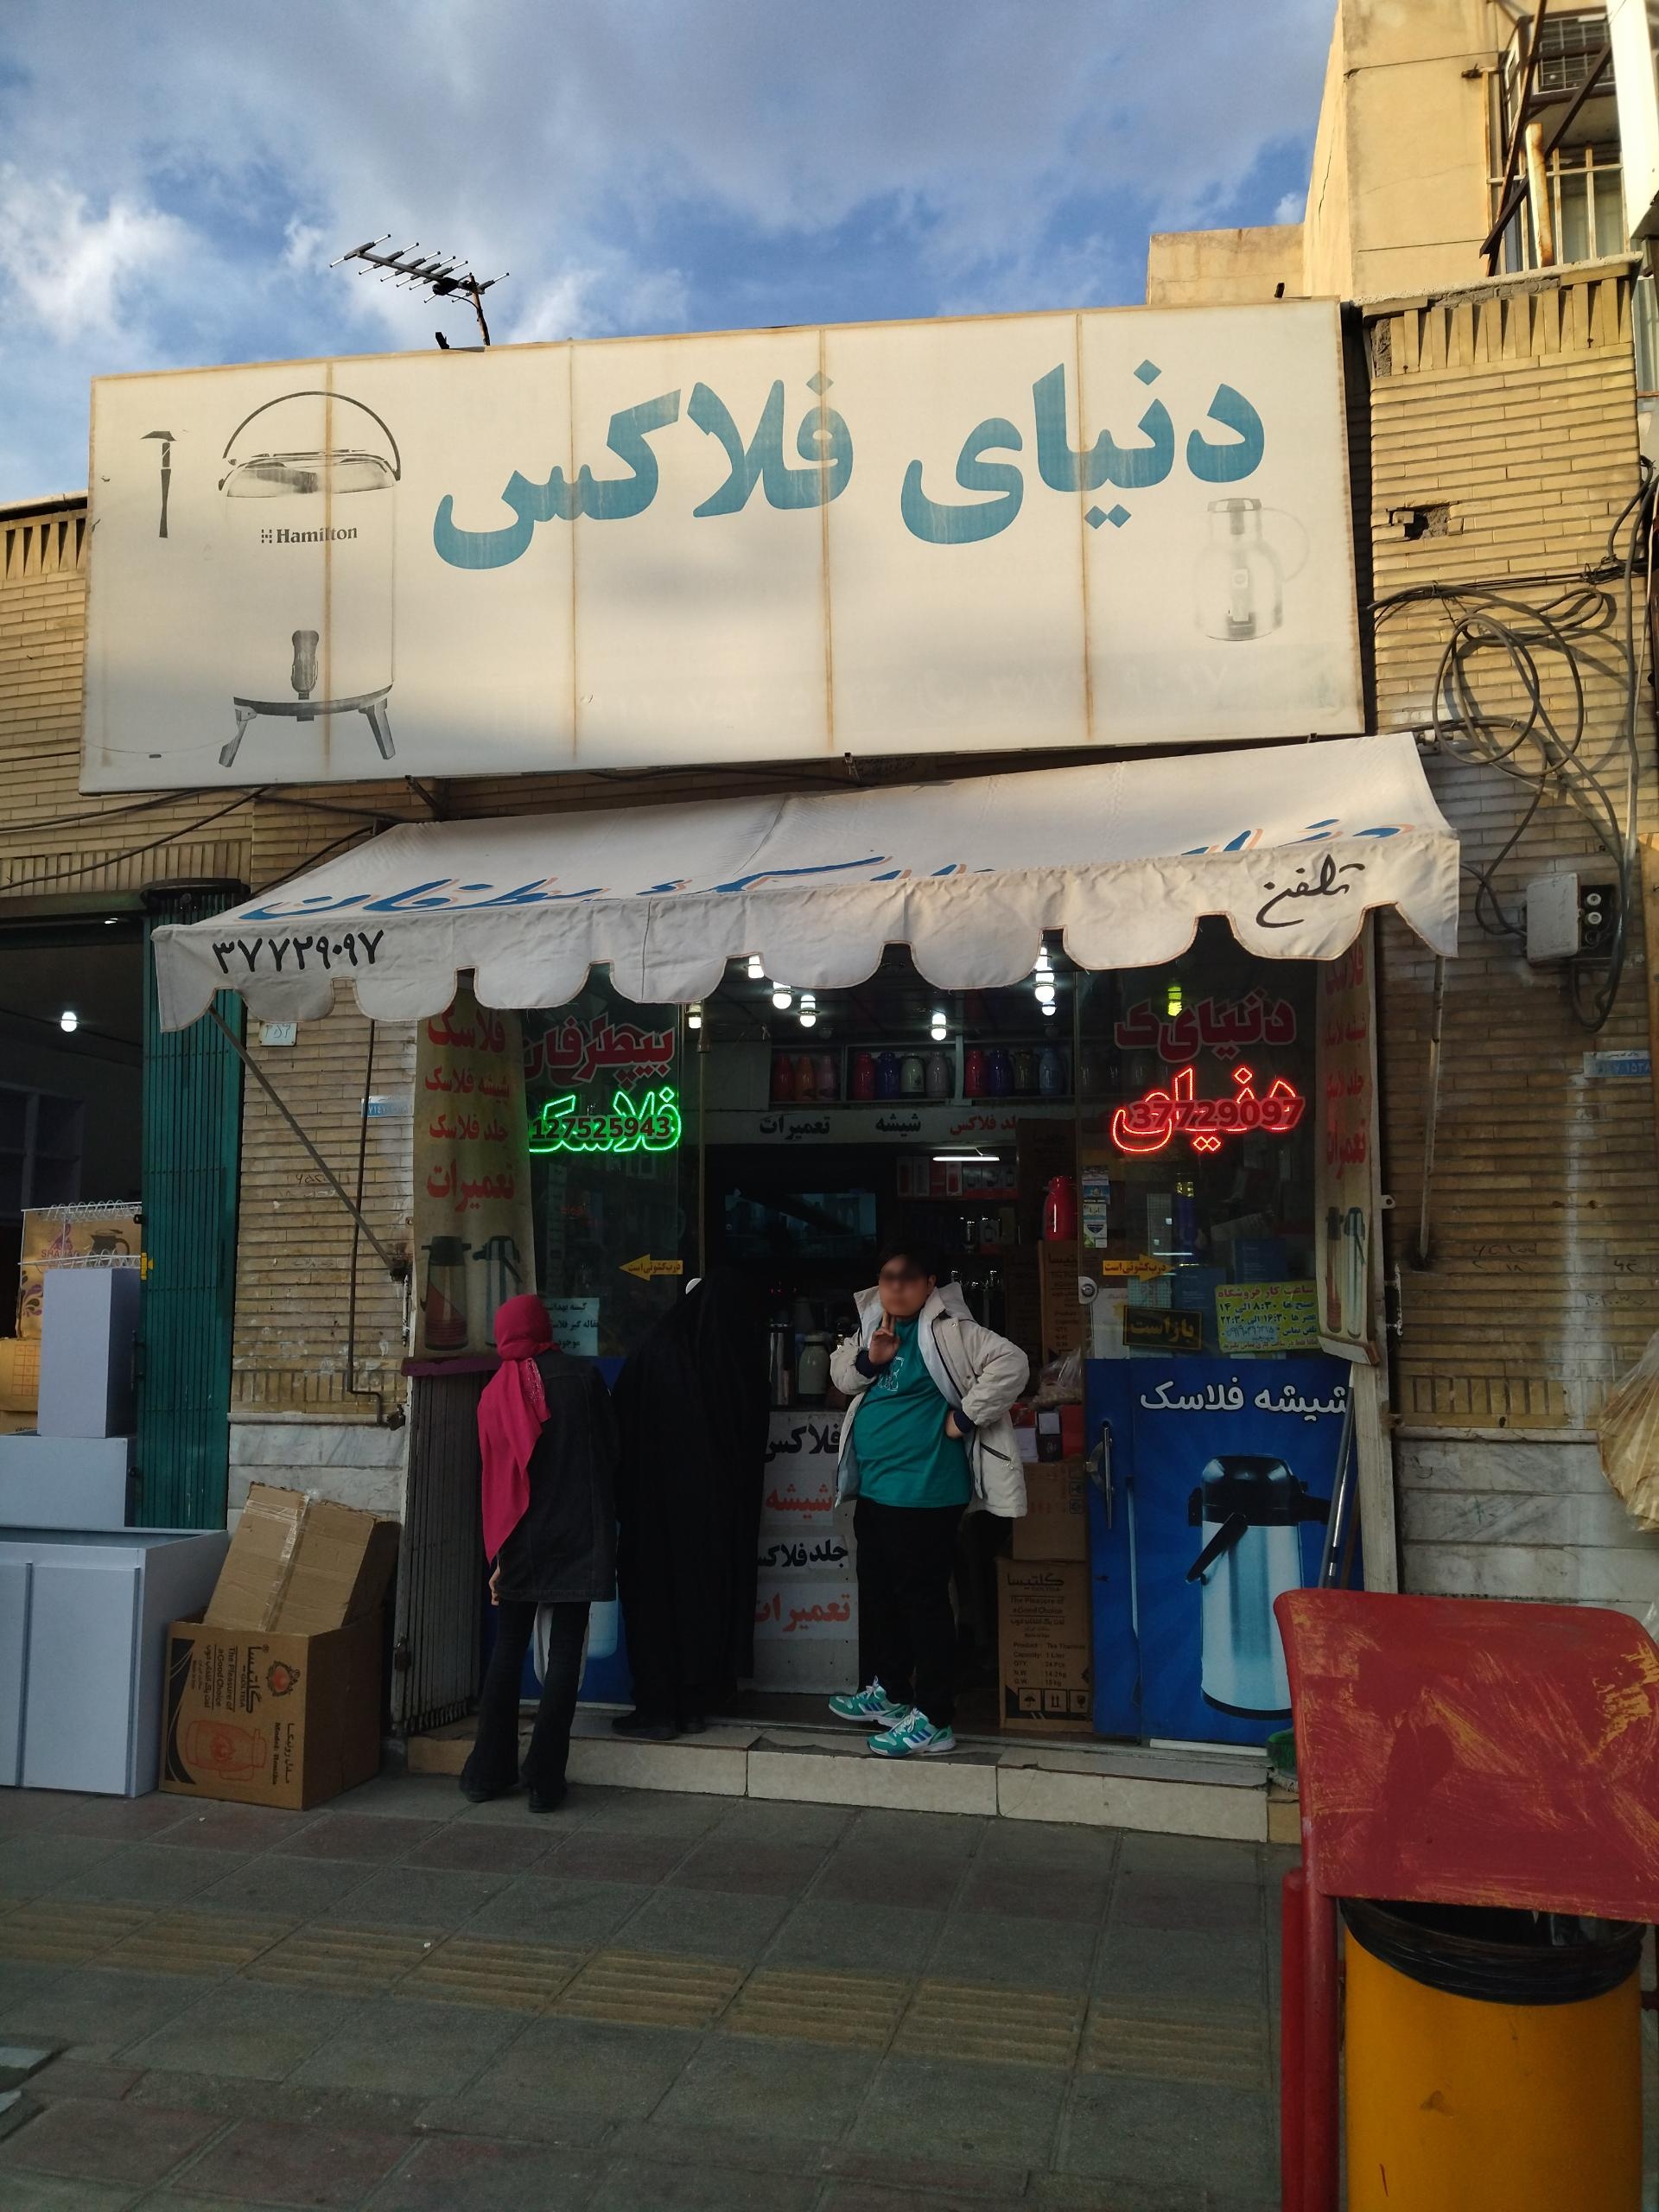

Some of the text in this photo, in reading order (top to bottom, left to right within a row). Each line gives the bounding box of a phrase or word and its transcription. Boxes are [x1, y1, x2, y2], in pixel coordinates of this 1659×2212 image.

[433, 359, 1265, 569] دنیای فلاکس
[276, 526, 358, 544] Hamilton
[1255, 854, 1365, 929] تلفن
[212, 929, 385, 975] ۳۷۷۲۹۰۹۷
[1157, 991, 1297, 1064] دنیای
[424, 1065, 474, 1094] فلاسک
[429, 1113, 480, 1141] فلاسک
[759, 1115, 831, 1141] تعمیرات
[875, 1113, 922, 1137] شیشه
[1131, 1097, 1305, 1130] 37729097
[426, 1159, 515, 1213] تعمیرات
[1140, 1376, 1348, 1422] شیشه فلاسک
[760, 1422, 841, 1463] فلاکس
[764, 1483, 833, 1522] شیشه
[809, 1539, 849, 1568] جلد
[226, 1701, 232, 1711] of
